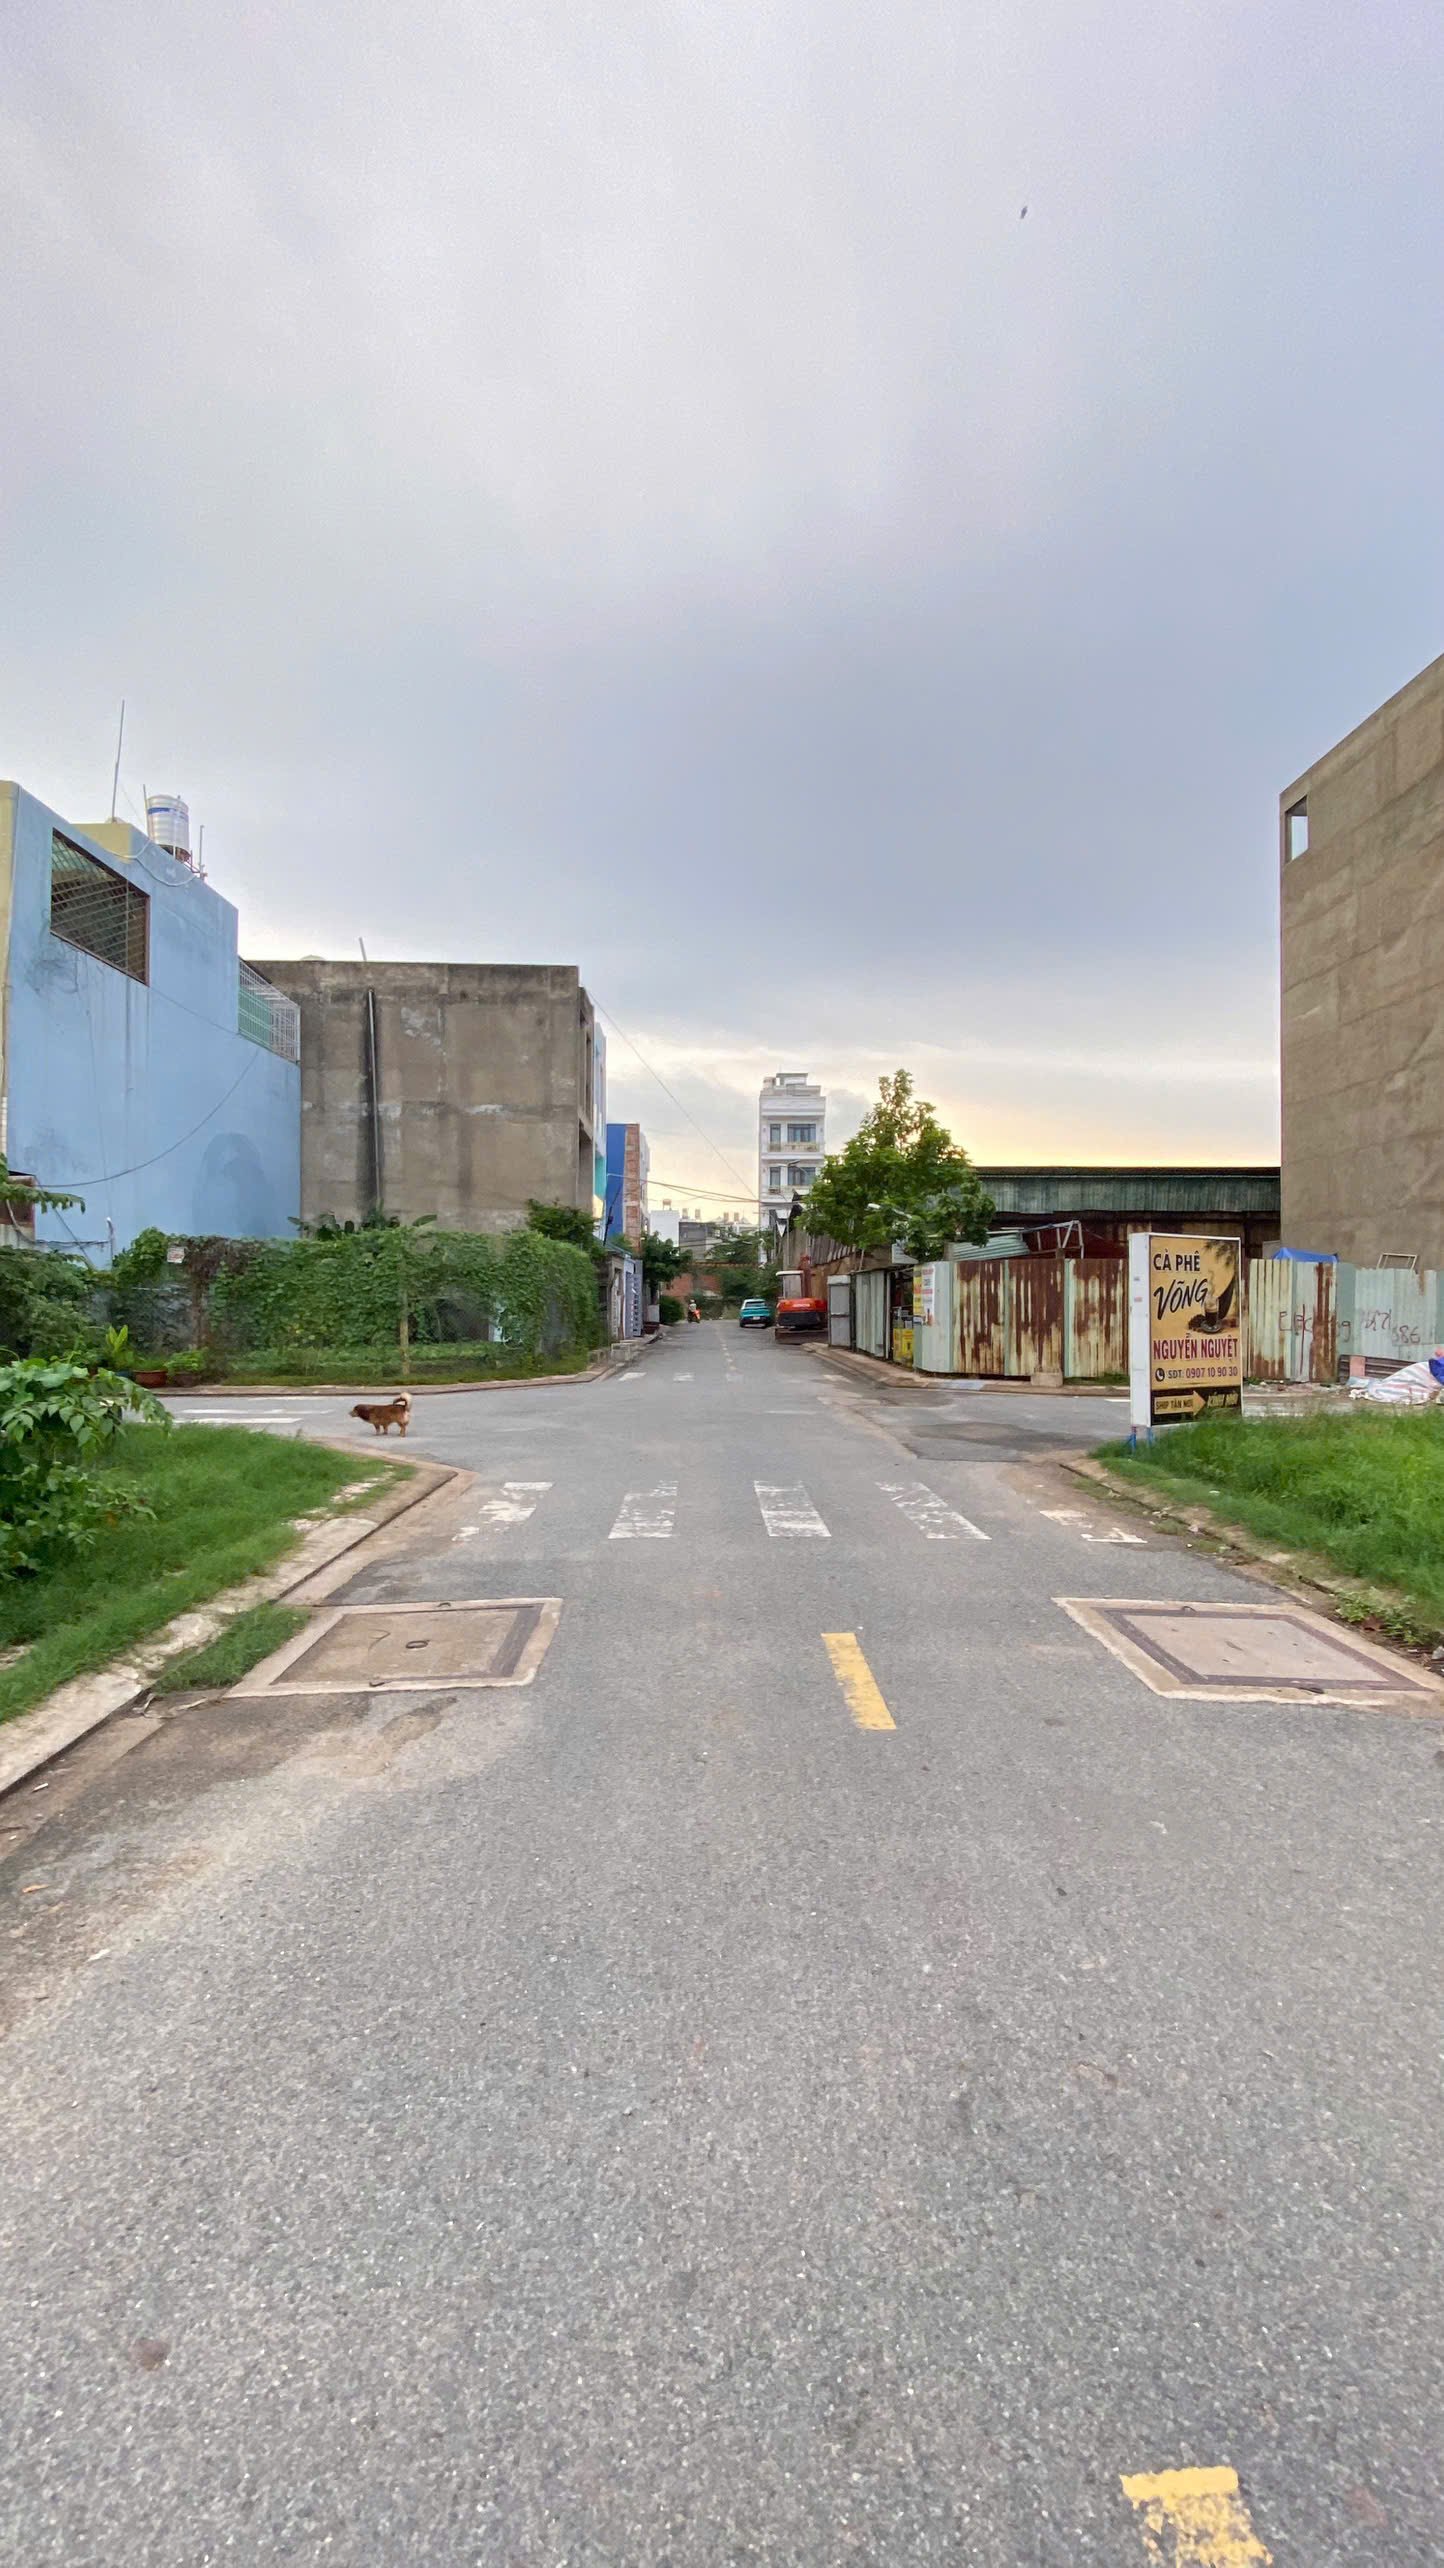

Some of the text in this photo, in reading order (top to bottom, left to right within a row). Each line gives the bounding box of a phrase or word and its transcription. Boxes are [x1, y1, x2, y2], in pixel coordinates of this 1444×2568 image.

[1153, 1249, 1200, 1271] CÀ PHÊ
[1153, 1278, 1208, 1320] VÕNG
[1153, 1333, 1238, 1361] NGUYỄN NGUYỆT
[1186, 1367, 1205, 1378] 0907
[1207, 1367, 1215, 1378] 10
[1217, 1367, 1227, 1377] 90
[1229, 1366, 1238, 1377] 30
